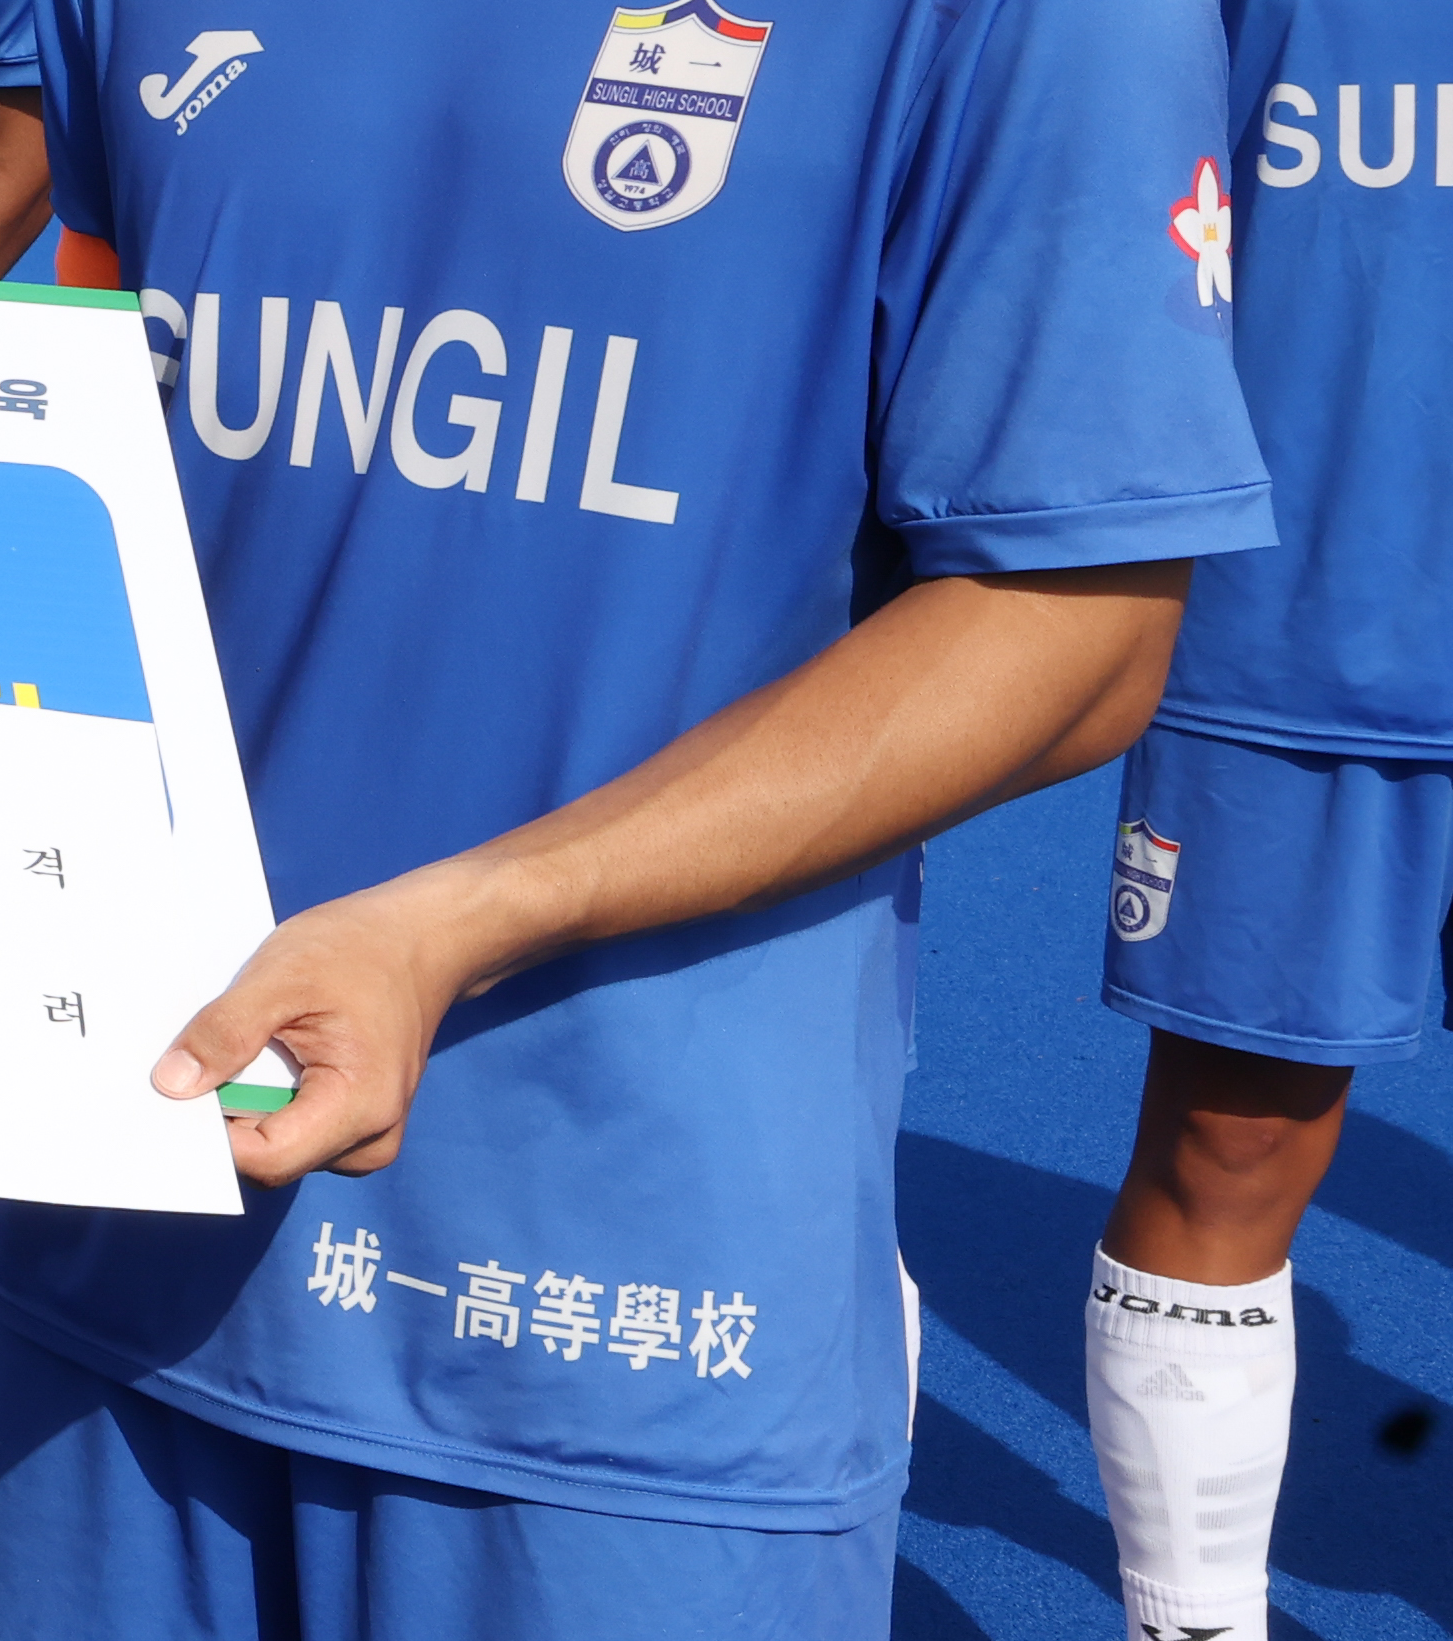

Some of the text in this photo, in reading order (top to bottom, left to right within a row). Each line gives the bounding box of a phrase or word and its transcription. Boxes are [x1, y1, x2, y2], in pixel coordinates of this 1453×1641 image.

[593, 82, 735, 118] SUNGIL HIGH SCHOOL
[307, 1221, 758, 1380] 城一高等學校
